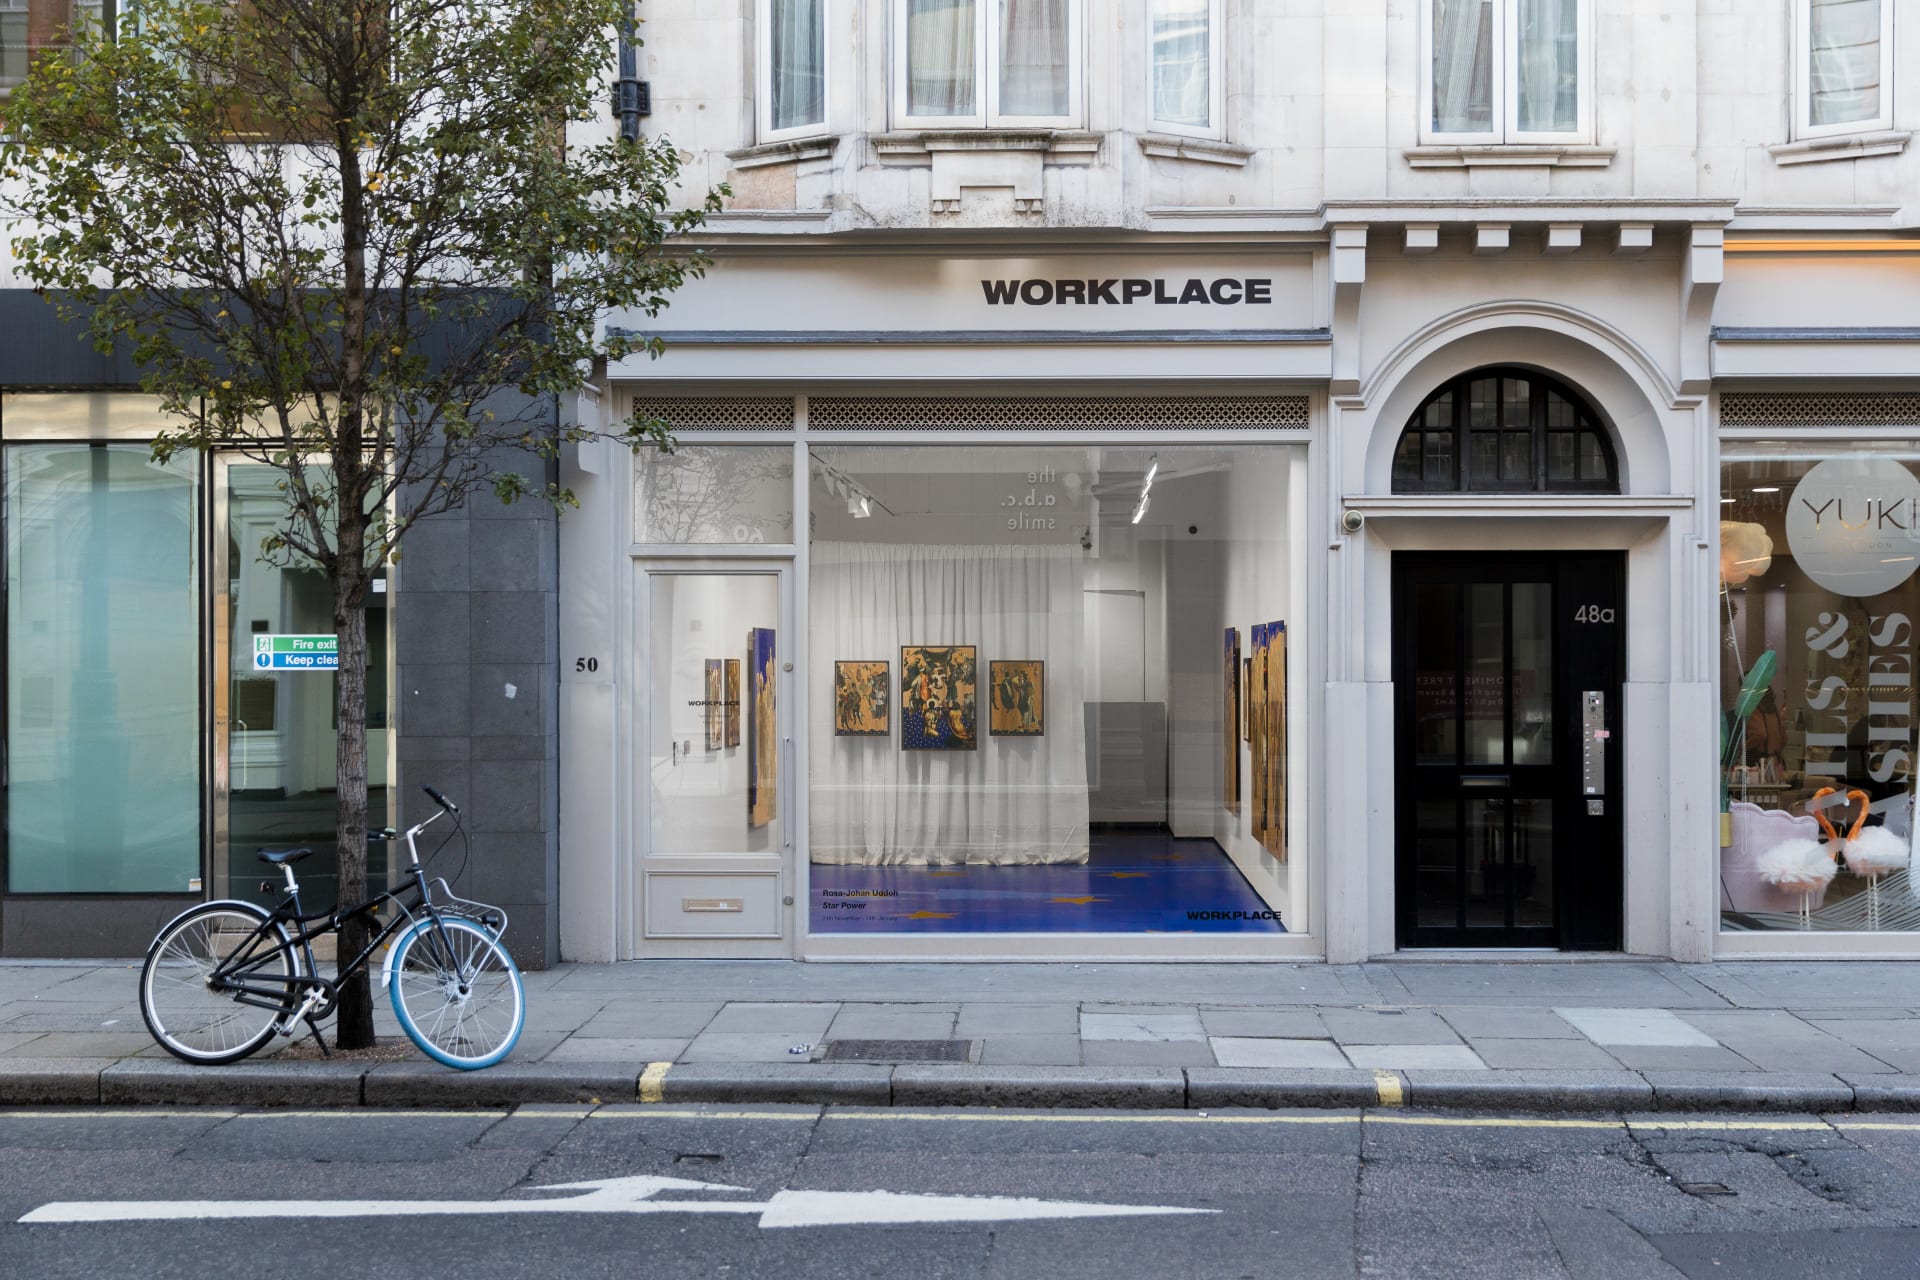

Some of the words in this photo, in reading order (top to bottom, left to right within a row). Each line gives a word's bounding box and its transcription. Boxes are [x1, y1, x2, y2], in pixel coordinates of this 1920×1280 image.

[981, 279, 1272, 305] WORKPLACE
[1801, 498, 1917, 532] YUKI
[1573, 604, 1615, 623] 48a
[1804, 611, 1849, 660] &
[293, 639, 313, 649] Fire
[317, 639, 337, 649] exit
[285, 655, 313, 667] Keep
[316, 655, 339, 665] clea
[575, 657, 599, 673] 50
[822, 889, 870, 897] Rosa-Johan
[872, 889, 899, 897] Uddoh
[1186, 910, 1282, 921] WORKPLACE
